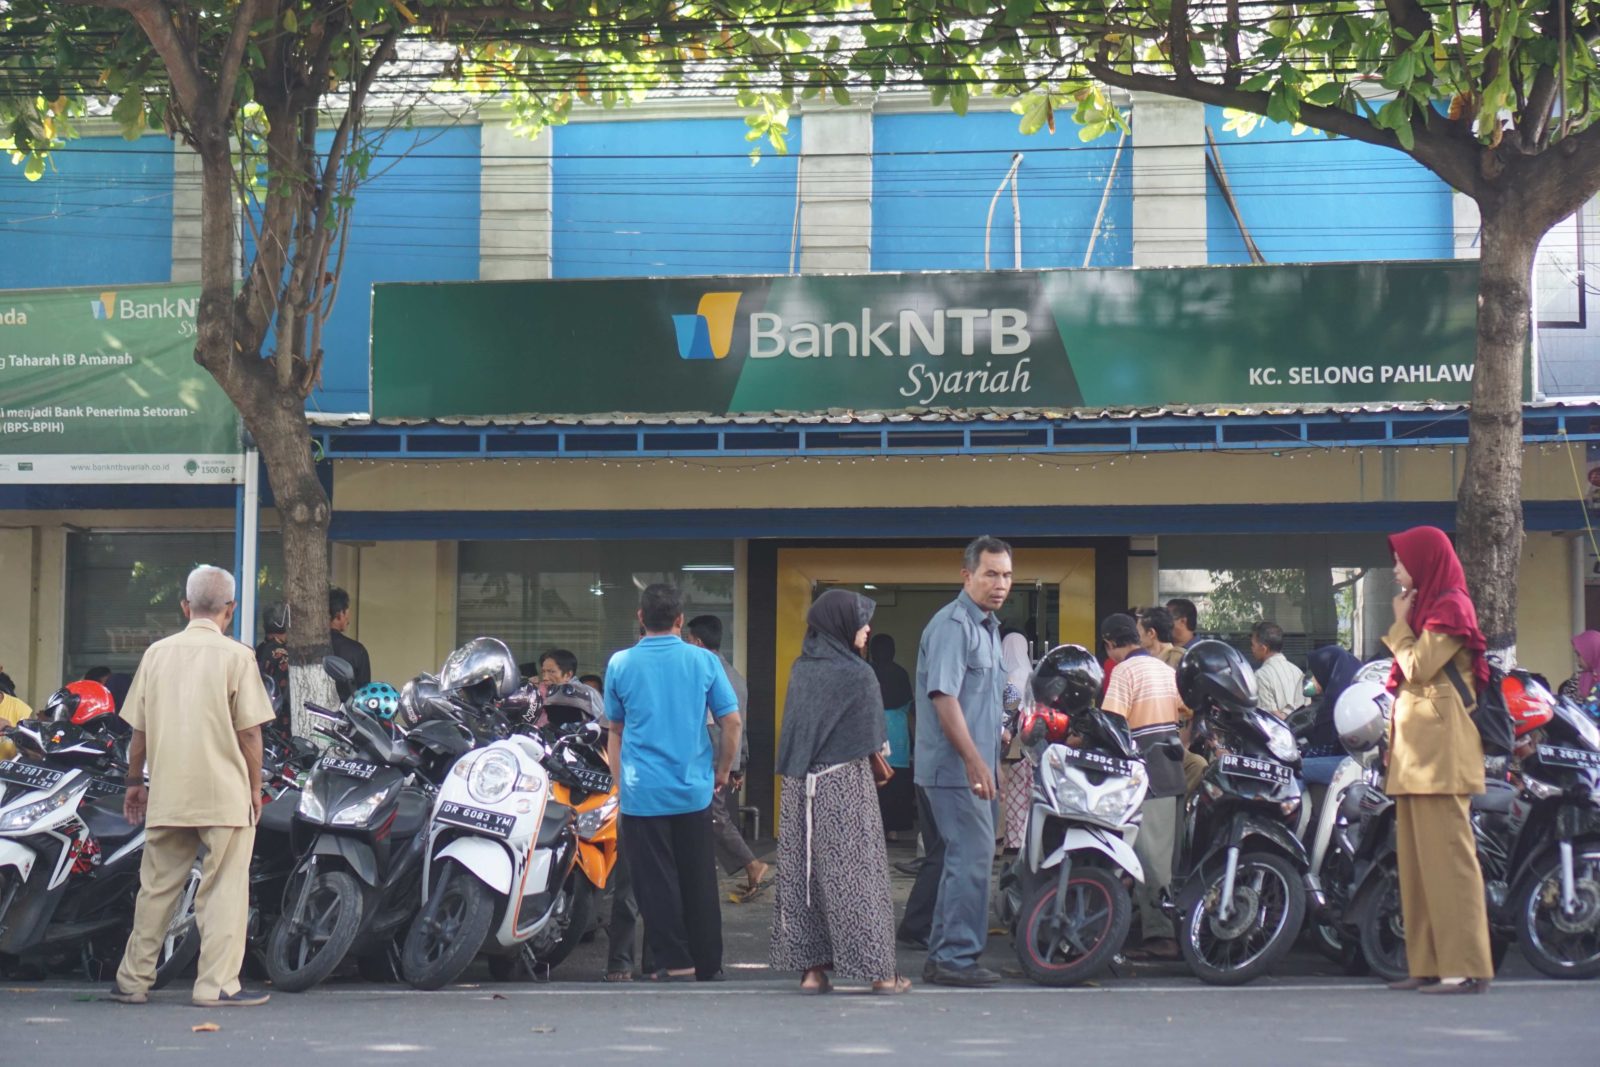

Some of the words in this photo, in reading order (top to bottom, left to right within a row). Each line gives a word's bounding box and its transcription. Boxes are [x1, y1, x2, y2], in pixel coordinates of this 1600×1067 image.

[120, 297, 199, 319] BankN
[9, 354, 60, 367] Taharah
[79, 353, 133, 366] Amanah
[899, 357, 1031, 405] Syariah
[1250, 367, 1282, 386] KC.
[1288, 365, 1374, 385] SELONG
[7, 407, 52, 420] menjadi
[54, 407, 84, 418] Bank
[86, 406, 141, 418] Penerima
[142, 406, 188, 417] Setoran
[3, 422, 65, 434] (BPS-BPIH)
[1066, 749, 1080, 758] DR
[0, 760, 14, 772] DR
[322, 757, 337, 766] DR
[1224, 755, 1238, 766] DR
[1242, 758, 1271, 771] 5968
[443, 804, 459, 815] DR
[462, 808, 491, 822] 6083
[495, 816, 511, 827] YM
